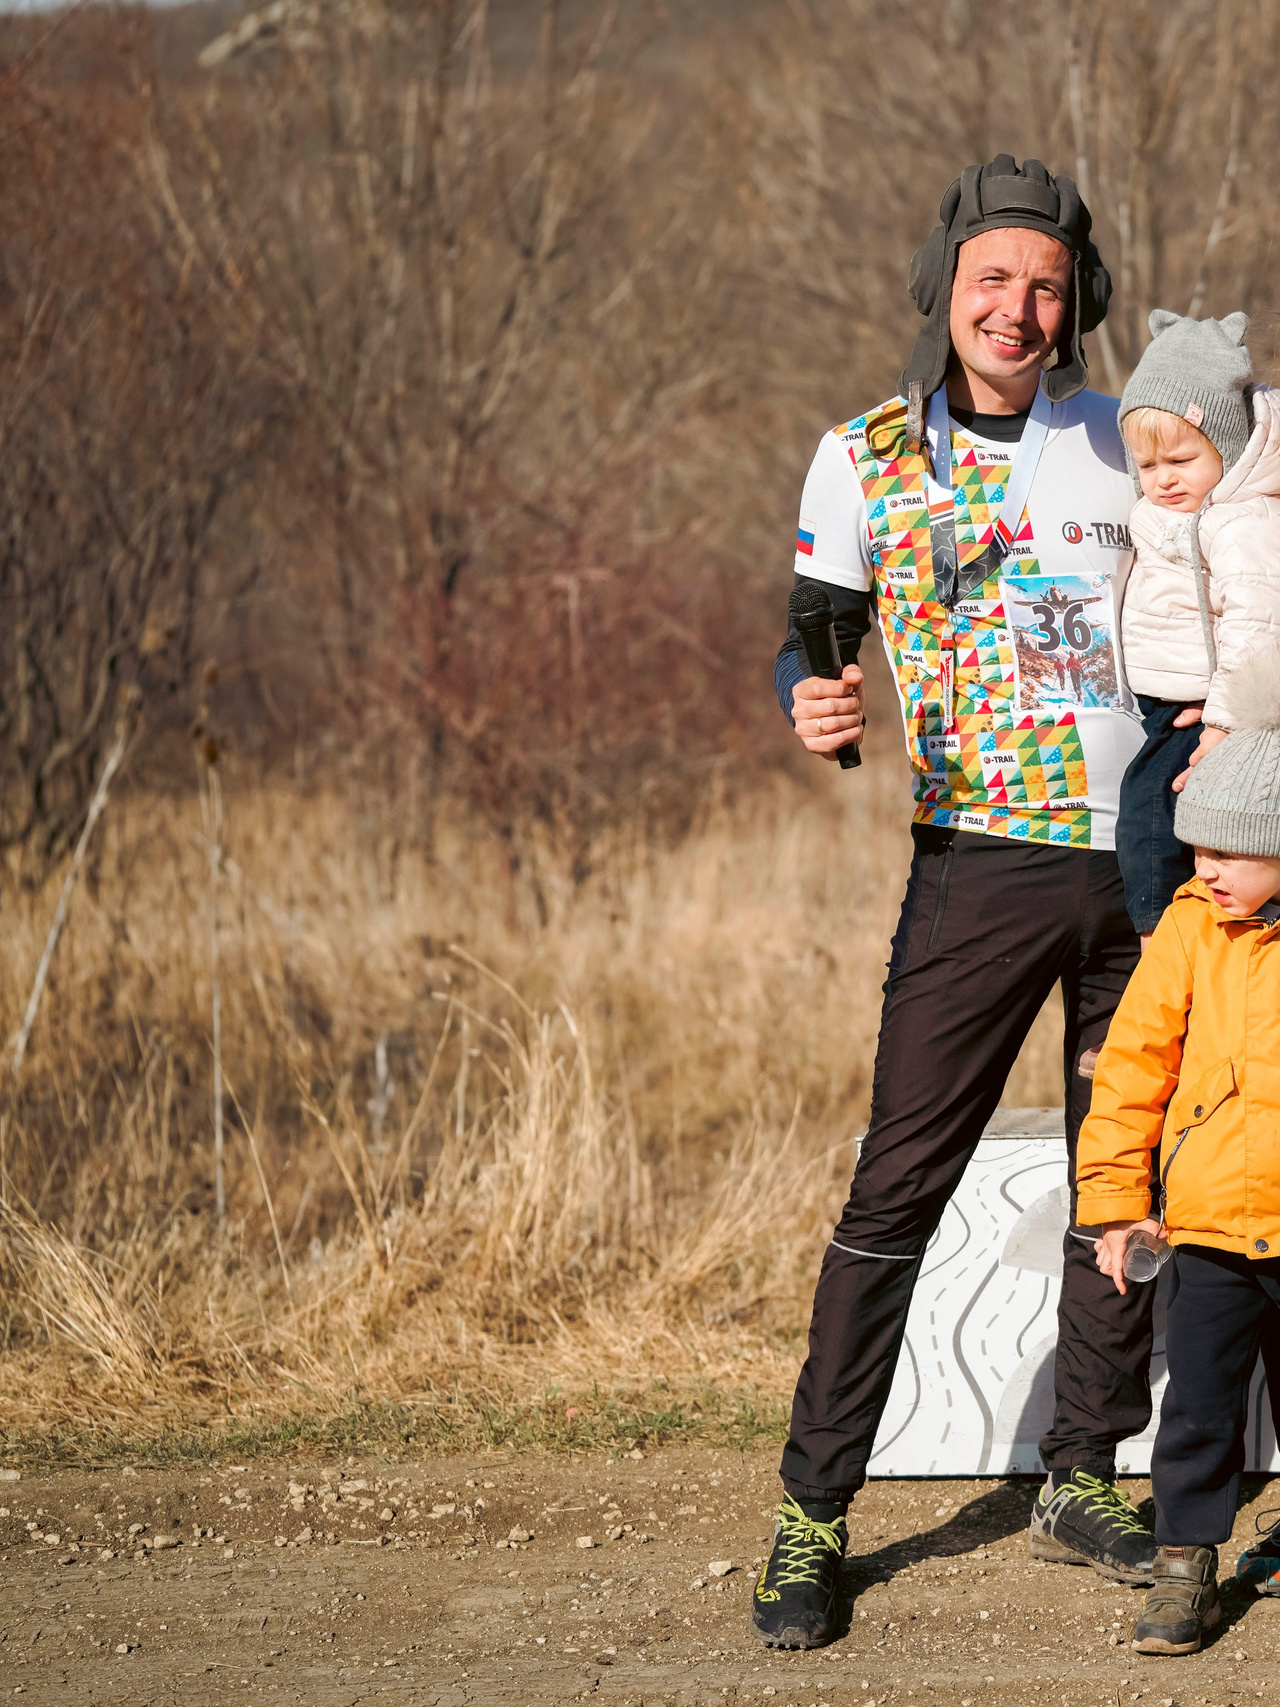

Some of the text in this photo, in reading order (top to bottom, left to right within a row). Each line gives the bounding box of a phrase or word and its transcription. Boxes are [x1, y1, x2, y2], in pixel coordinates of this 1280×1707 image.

[841, 432, 866, 442] -TRAIL
[1009, 547, 1033, 556] -TRAIL
[1031, 602, 1093, 653] 36
